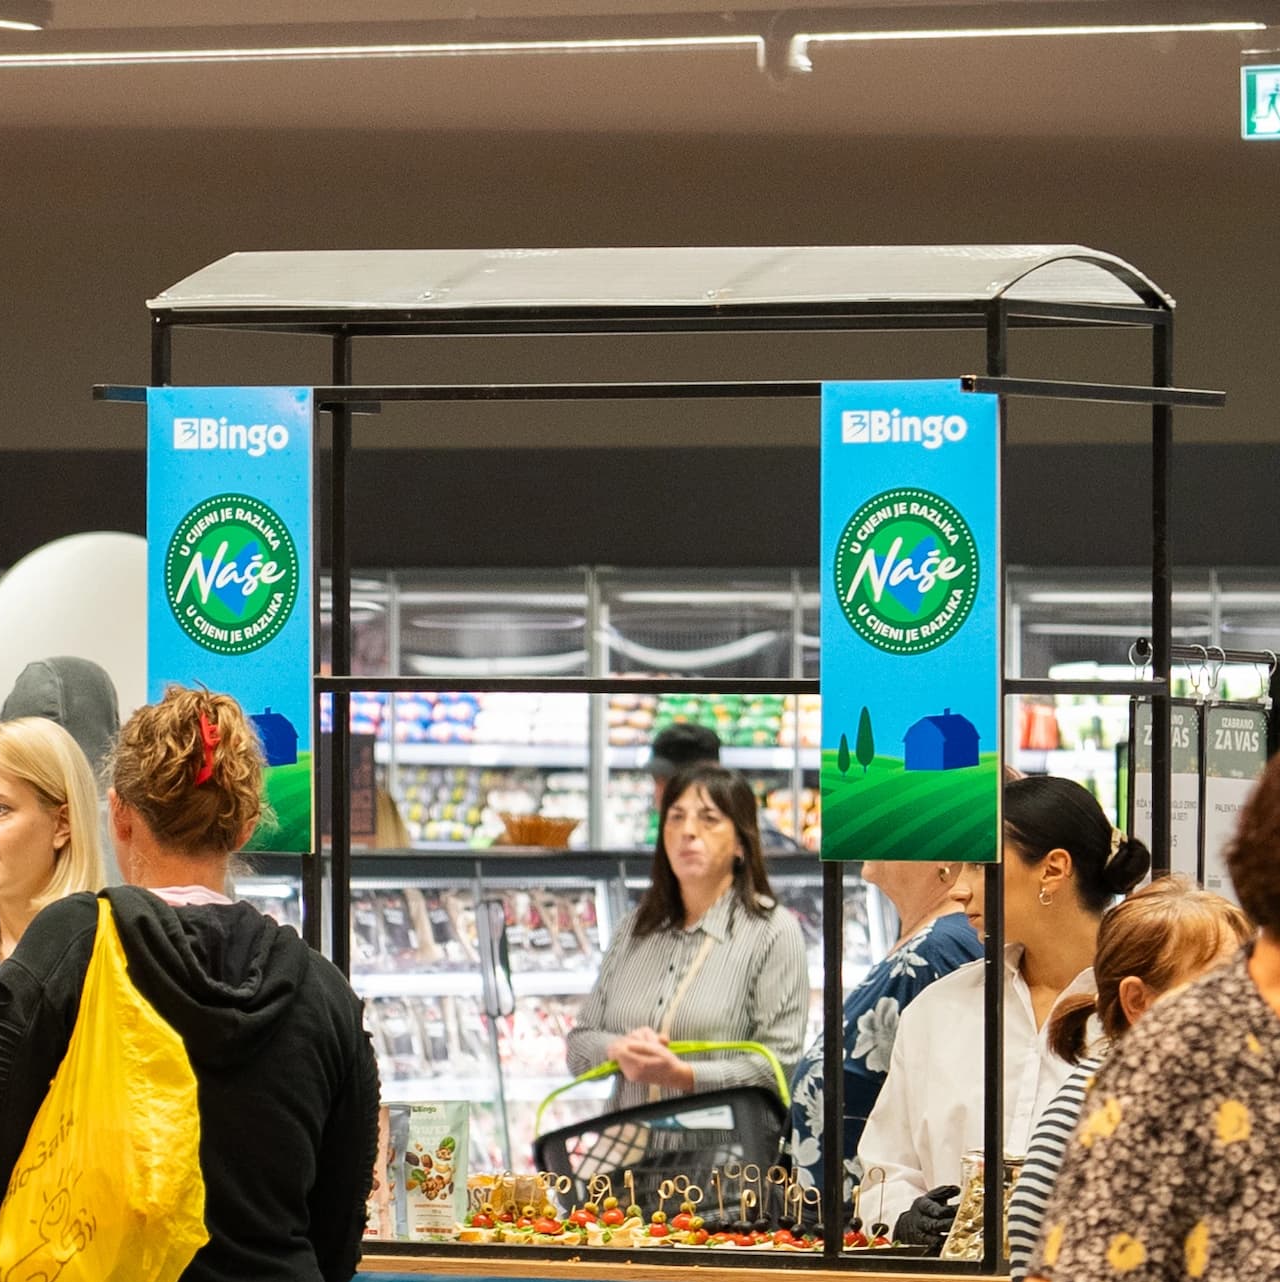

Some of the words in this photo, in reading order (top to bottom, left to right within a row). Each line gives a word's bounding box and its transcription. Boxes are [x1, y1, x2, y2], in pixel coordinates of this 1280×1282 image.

[199, 416, 289, 457] Bingo
[870, 408, 968, 450] Bingo
[179, 544, 191, 557] U
[186, 510, 219, 545] CIJENI
[220, 507, 233, 522] JE
[235, 508, 281, 551] RAZLIKA
[849, 541, 862, 555] U
[856, 505, 892, 541] CIJENI
[893, 502, 908, 518] JE
[909, 502, 959, 547] RAZLIKA
[175, 541, 286, 604] Naše
[845, 536, 966, 603] Naše
[185, 604, 199, 618] U
[193, 615, 228, 642] CIJENI
[230, 629, 242, 644] JE
[243, 592, 285, 640] RAZLIKA
[857, 603, 872, 617] U
[865, 613, 903, 642] CIJENI
[905, 628, 919, 644] JE
[920, 588, 964, 639] RAZLIKA
[1143, 725, 1153, 746] Z
[1214, 729, 1232, 750] ZA
[1235, 730, 1260, 752] VAS
[1221, 717, 1254, 729] IZABRANO
